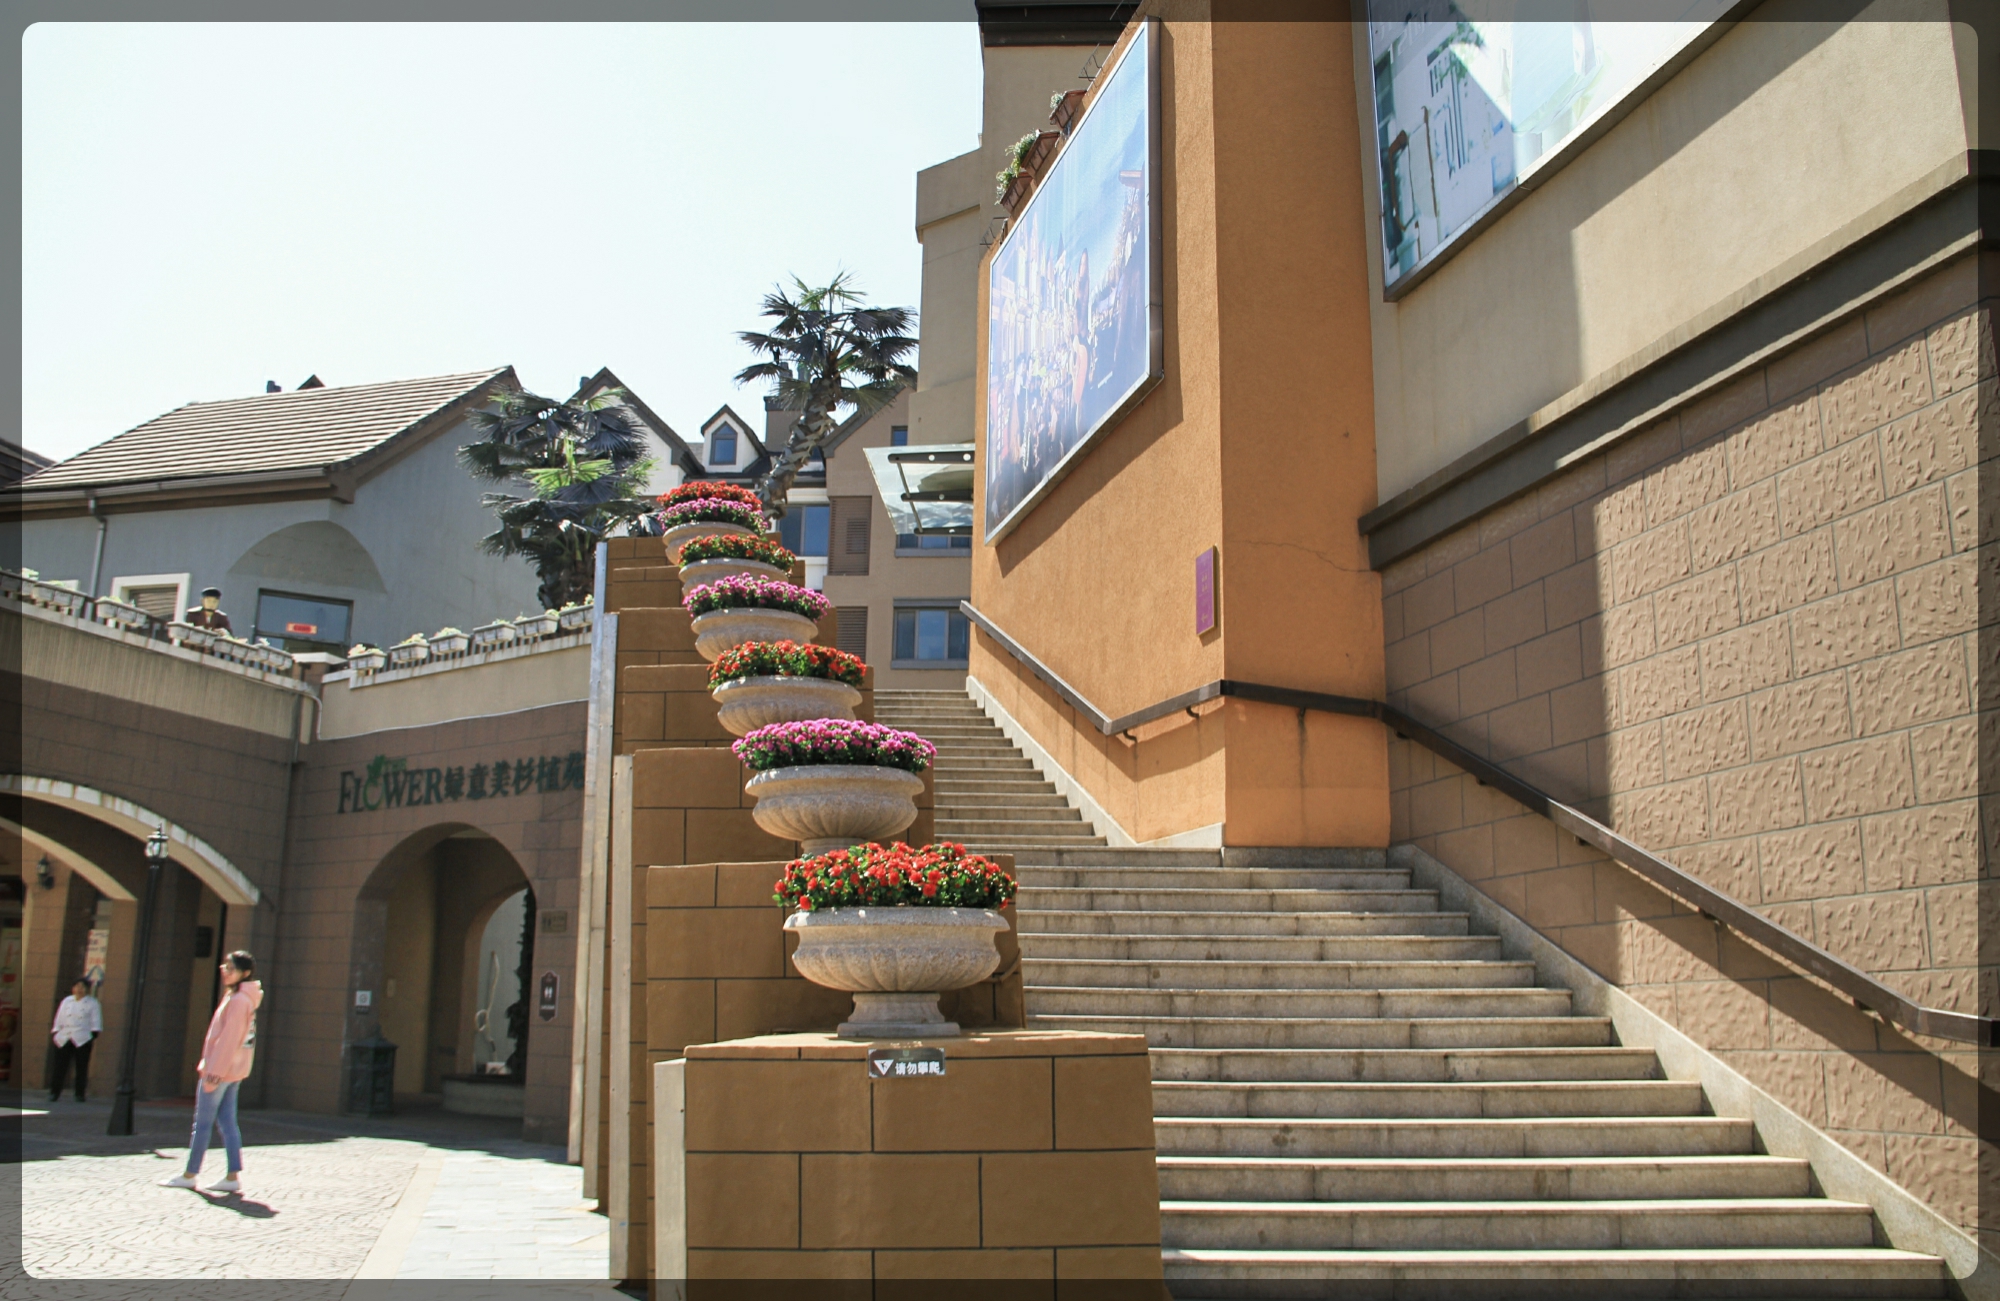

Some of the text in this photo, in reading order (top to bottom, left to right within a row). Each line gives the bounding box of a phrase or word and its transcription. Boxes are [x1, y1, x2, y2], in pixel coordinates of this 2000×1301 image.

[337, 764, 443, 814] FLOWER
[895, 1061, 940, 1075] 请勿攀爬
